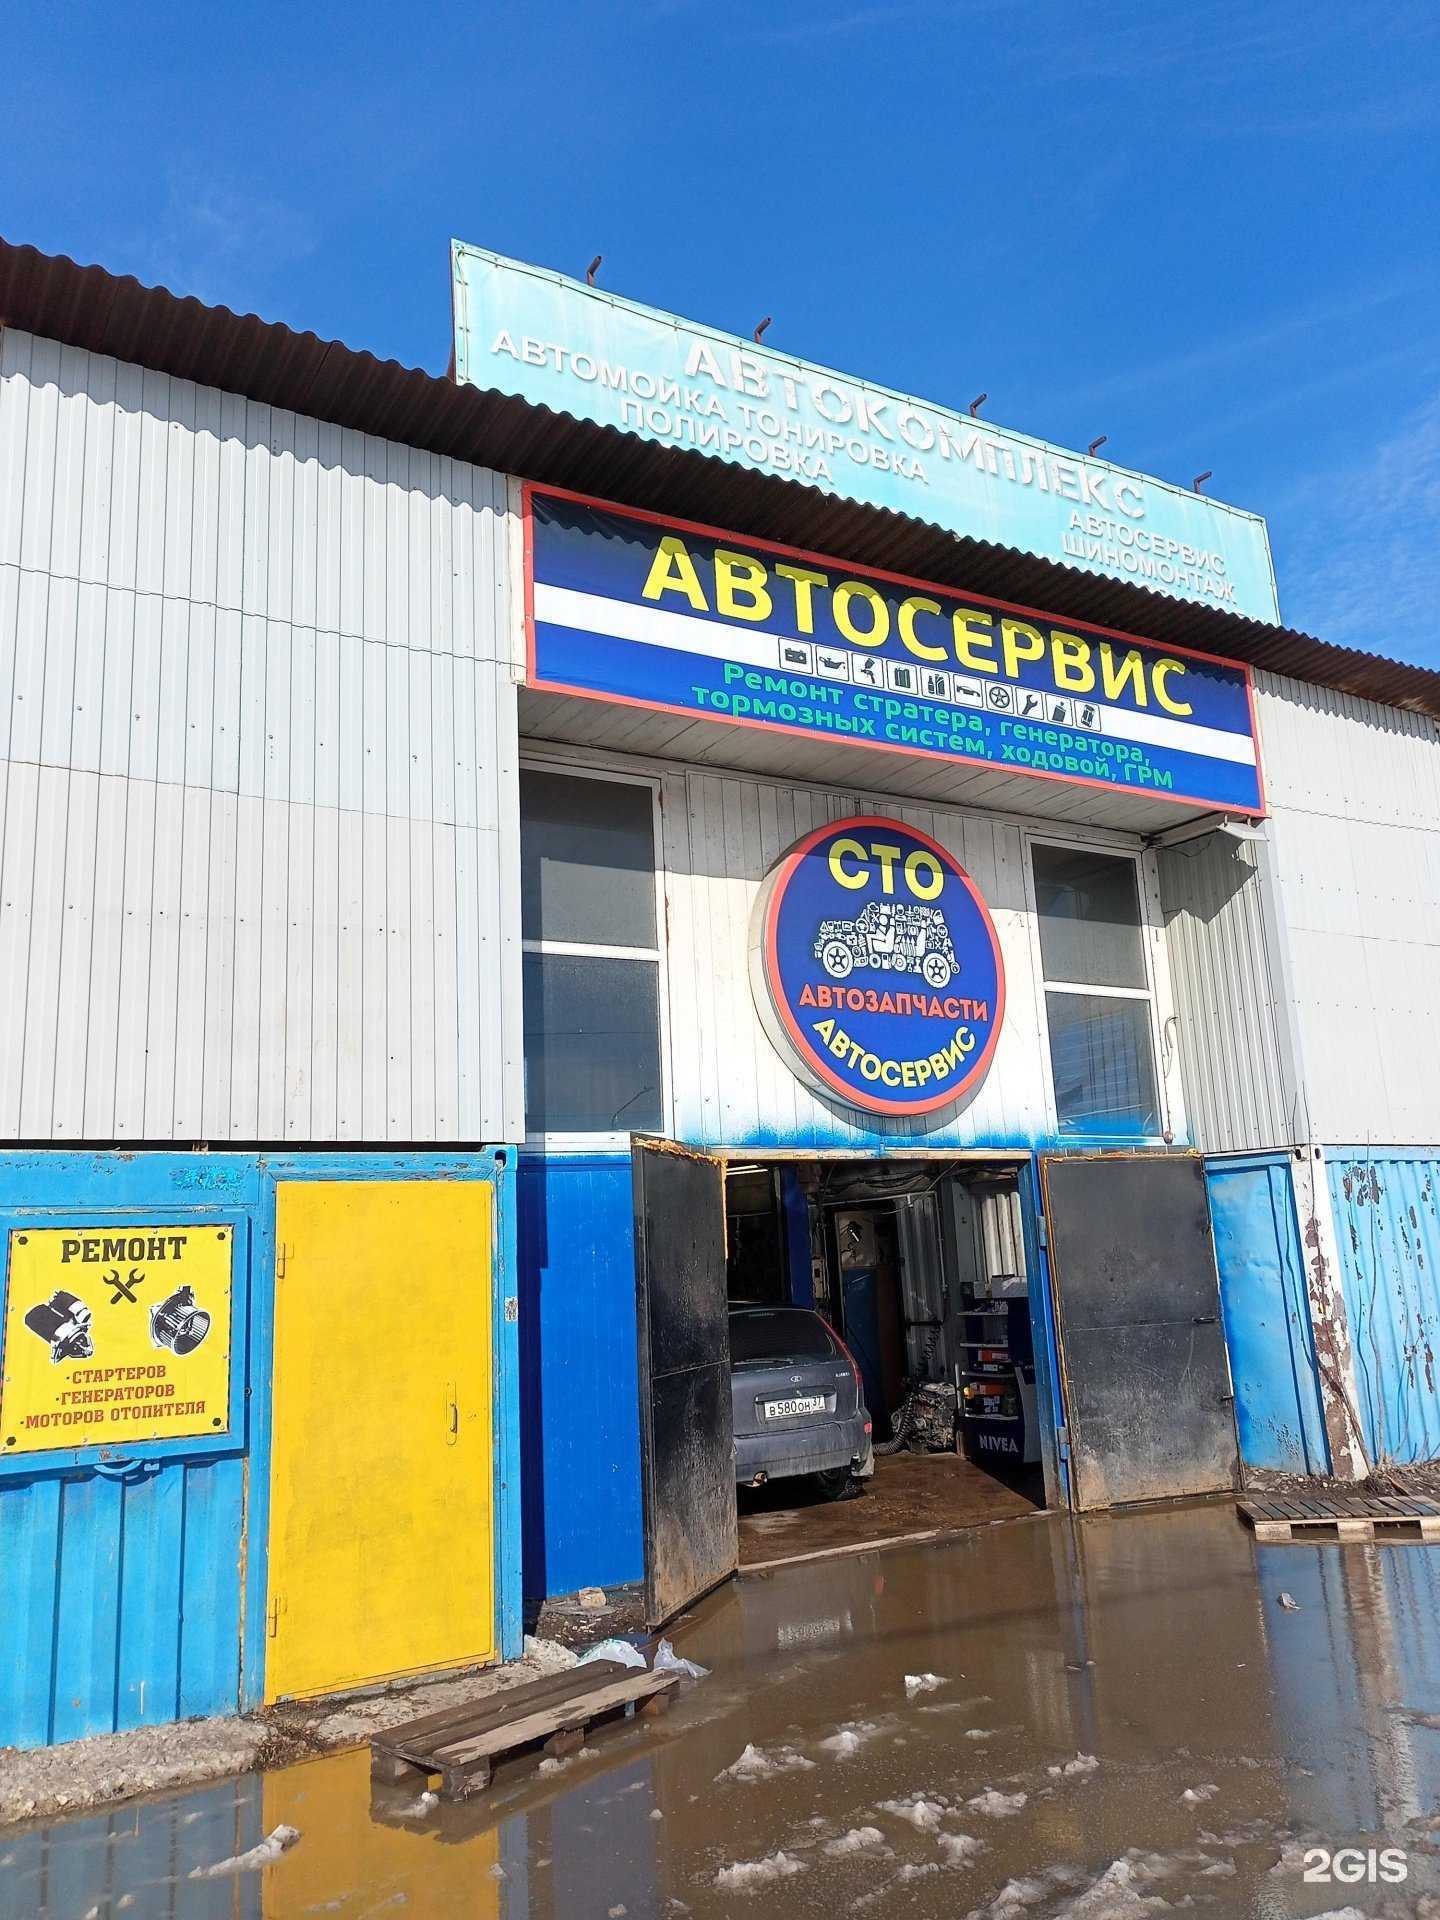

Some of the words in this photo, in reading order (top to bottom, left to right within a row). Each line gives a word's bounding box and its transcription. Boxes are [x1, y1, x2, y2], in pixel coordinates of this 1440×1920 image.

[490, 329, 728, 422] АВТОМОЙКА
[737, 404, 929, 484] ТОНИРОВКА
[685, 341, 1145, 519] АВТОКОМПЛЕКС
[619, 399, 835, 484] ПОЛИРОВКА
[1061, 532, 1236, 604] ШИНОМОНТАЖ
[1069, 509, 1226, 576] АВТОСЕРВИС
[642, 536, 1194, 716] АВТОСЕРВИС
[691, 685, 876, 735] тормозных
[886, 722, 993, 760] систем,
[1001, 743, 1117, 782] ходовой,
[1124, 764, 1174, 789] ГРМ
[724, 662, 844, 705] Ремонт
[854, 692, 991, 737] стратера,
[1000, 720, 1151, 767] генератора,
[828, 838, 945, 901] СТО
[799, 983, 989, 1022] АВТОЗАПЧАСТИ
[812, 1018, 976, 1088] АВТОСЕРВИС
[61, 1236, 188, 1263] РЕМОНТ
[61, 1384, 175, 1405] ГЕНЕРАТОРОВ
[72, 1365, 166, 1385] СТАРТЕРОВ
[25, 1409, 104, 1430] МОТОРОВ
[110, 1401, 206, 1422] ОТОПИТЕЛЯ
[979, 1434, 1019, 1453] NIVEA
